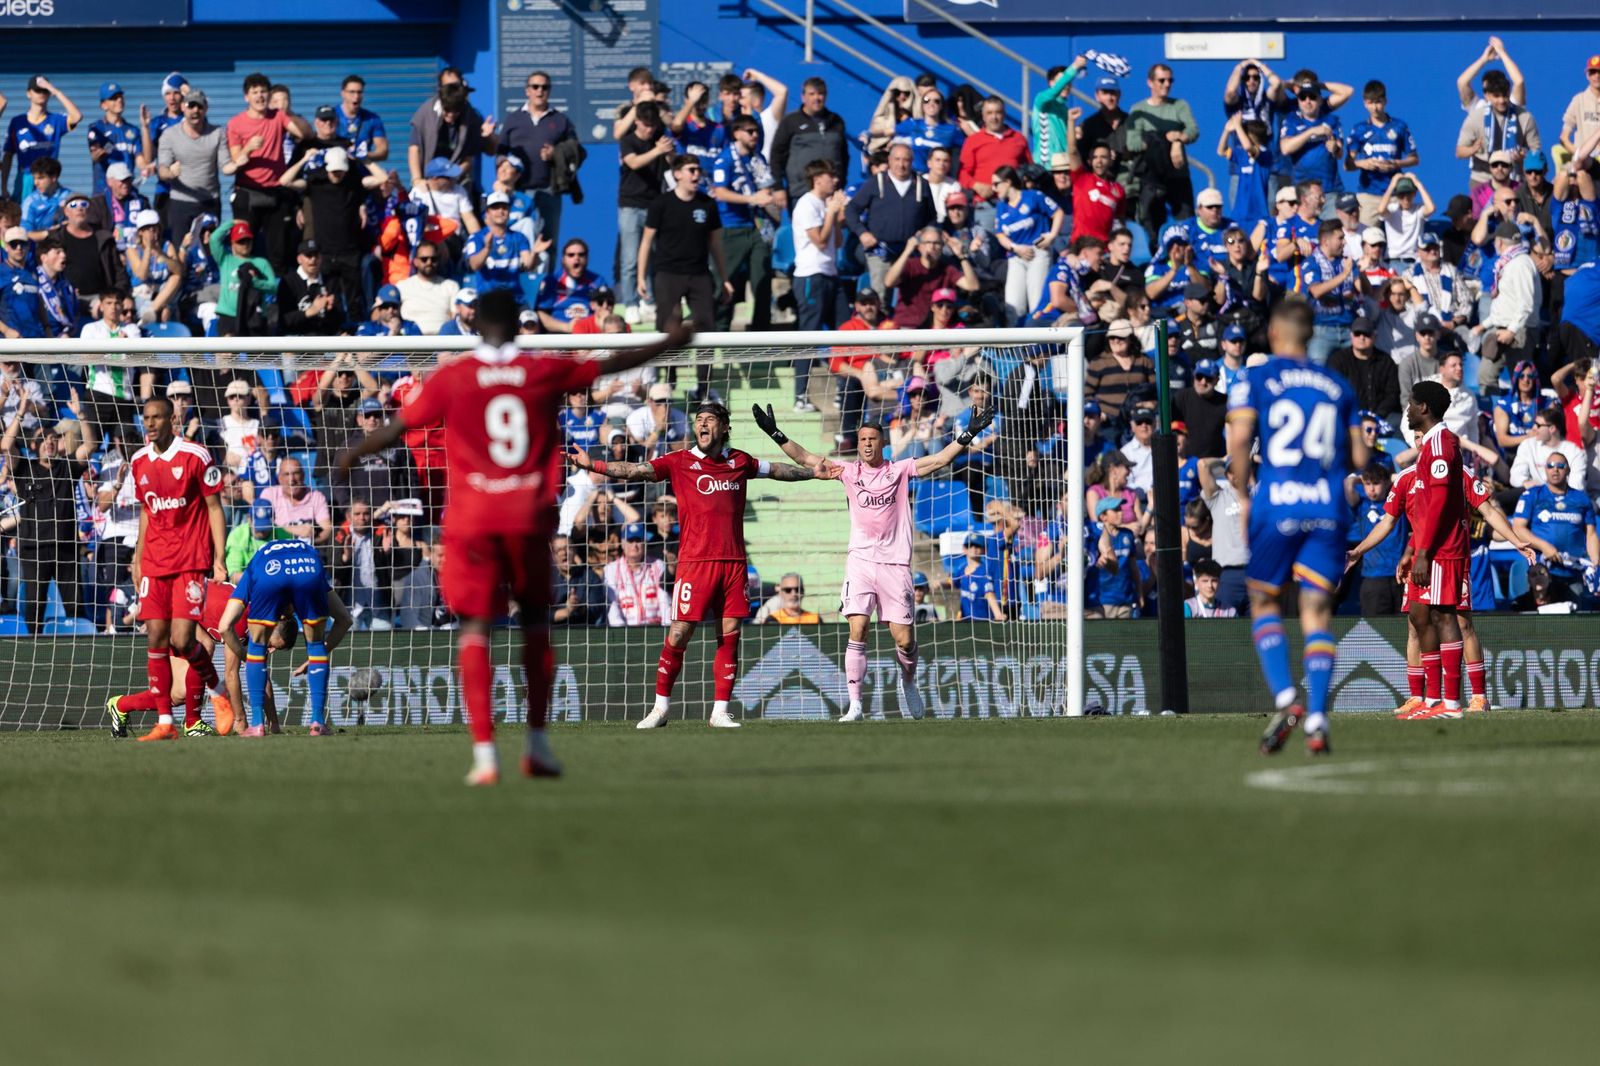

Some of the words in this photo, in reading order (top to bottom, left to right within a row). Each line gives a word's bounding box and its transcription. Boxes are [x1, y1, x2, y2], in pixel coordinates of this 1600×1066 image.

[484, 393, 530, 469] 9
[1267, 398, 1338, 470] 24
[206, 468, 219, 483] JD
[1433, 463, 1446, 475] JD
[145, 492, 187, 514] Midea
[284, 557, 316, 566] GRAND
[284, 565, 316, 575] CLASS
[680, 582, 692, 602] 6
